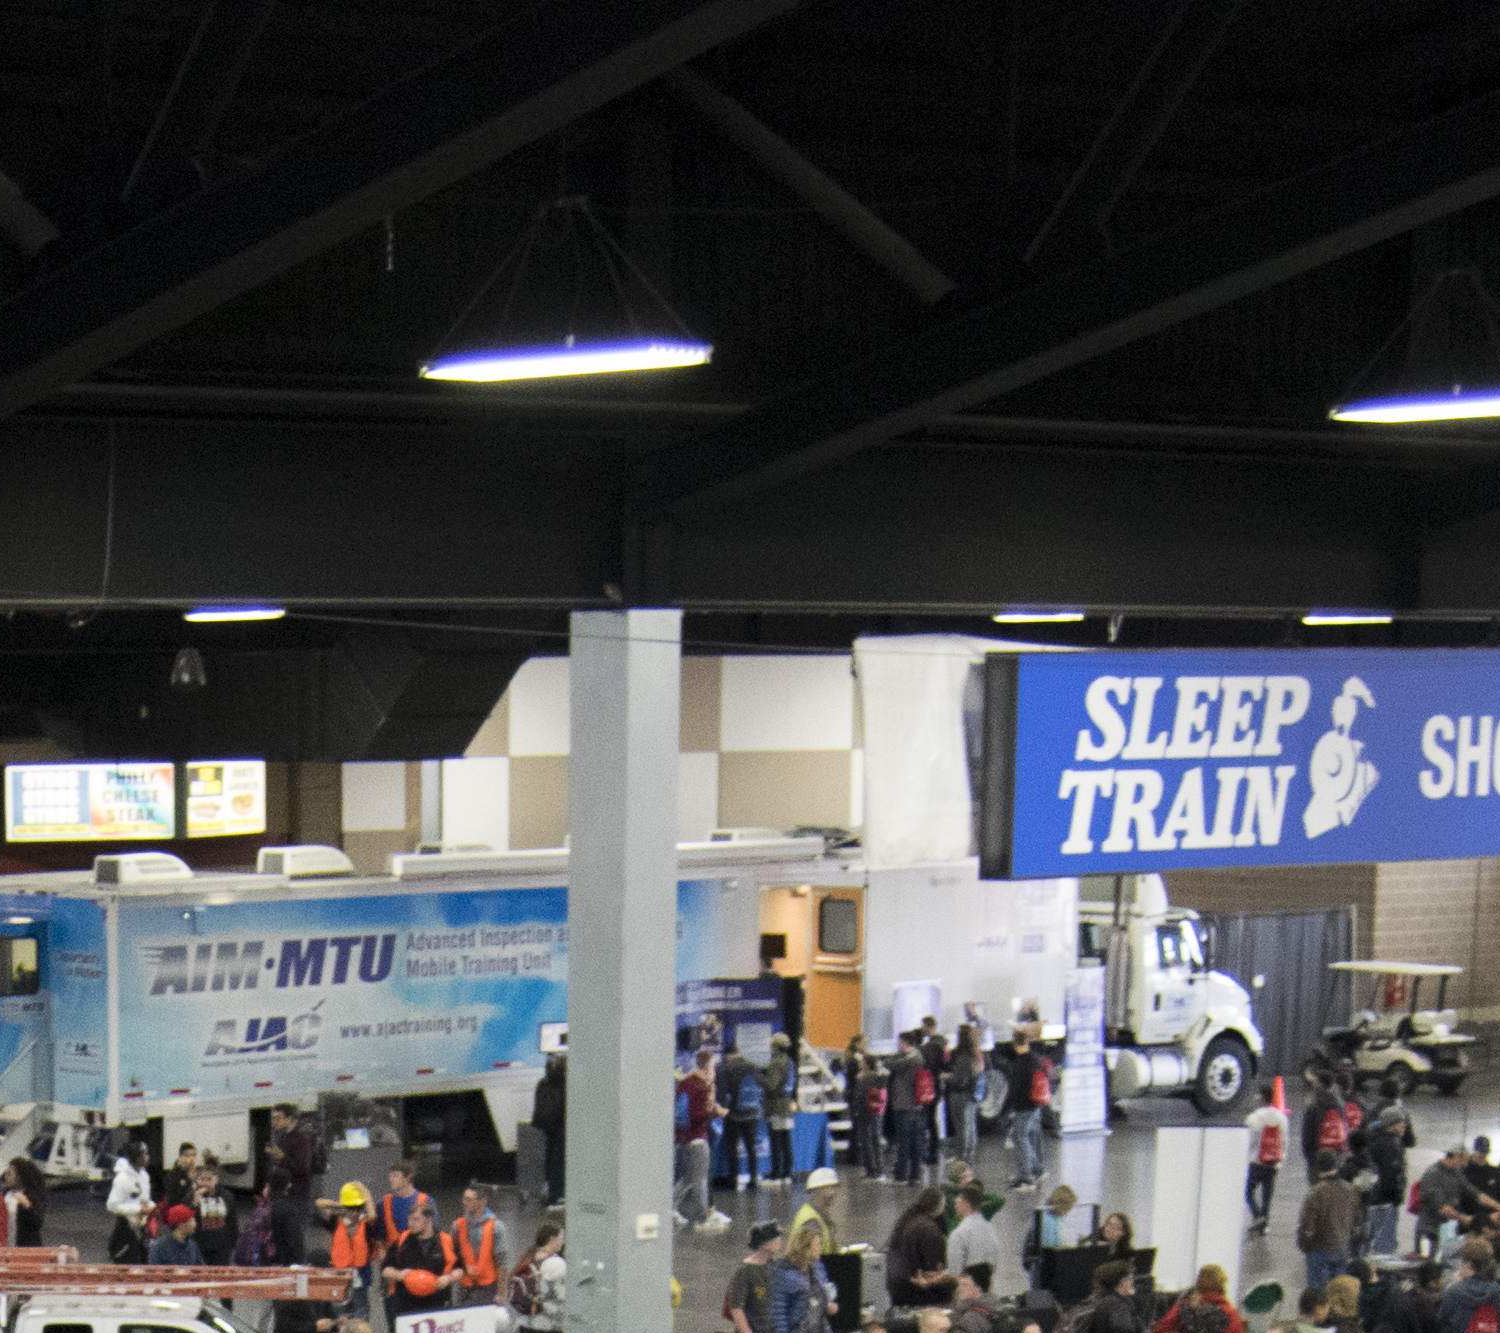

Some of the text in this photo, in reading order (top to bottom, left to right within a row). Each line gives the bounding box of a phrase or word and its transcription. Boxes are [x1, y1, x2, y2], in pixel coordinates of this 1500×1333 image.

[1075, 676, 1311, 761] SLEEP
[103, 788, 159, 804] CHEESE
[1058, 765, 1297, 855] TRAIN
[107, 807, 156, 822] STEAK
[406, 930, 477, 952] Advanced
[481, 926, 553, 951] Inspection
[406, 951, 553, 980] Mobile Training Unit
[203, 1005, 322, 1056] AJAC
[339, 1013, 479, 1040] www.ajactraining.org
